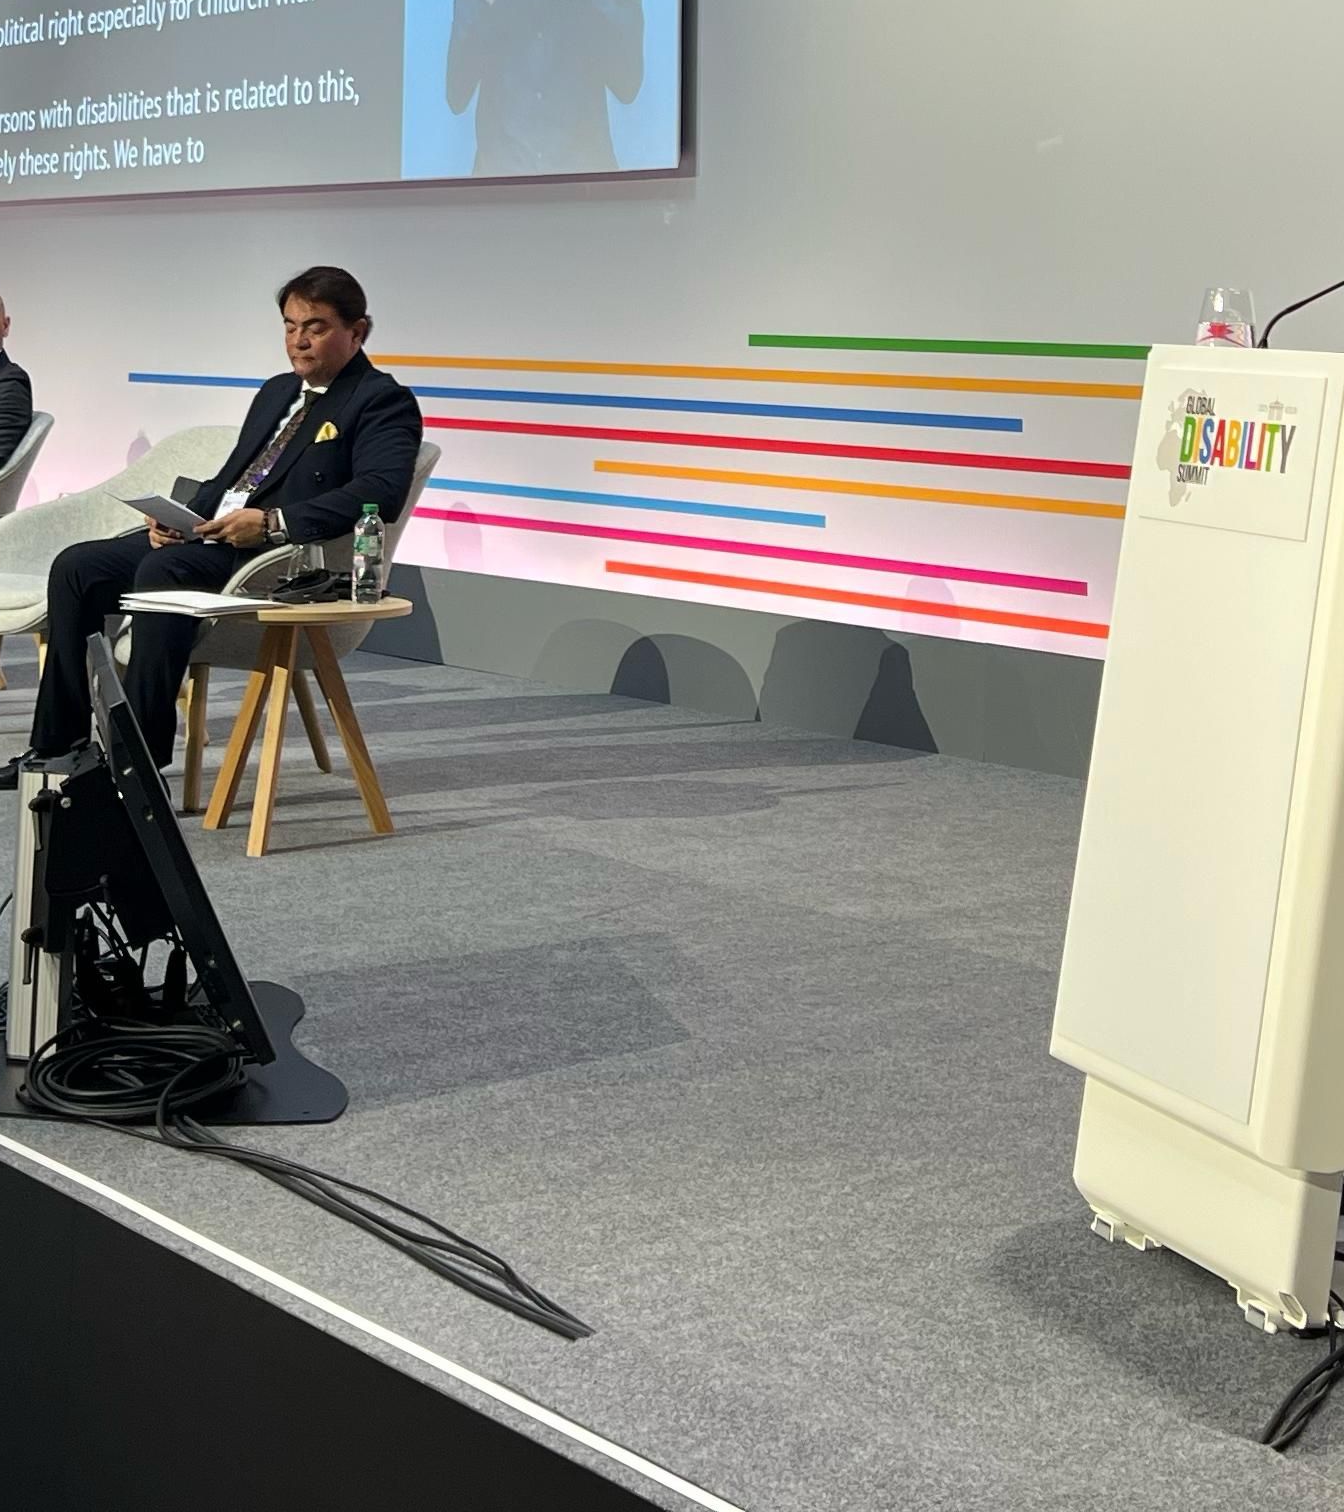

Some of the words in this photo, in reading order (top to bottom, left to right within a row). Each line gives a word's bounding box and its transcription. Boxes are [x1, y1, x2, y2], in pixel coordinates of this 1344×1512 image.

[48, 9, 84, 45] right
[39, 99, 72, 129] with
[76, 90, 162, 126] disabilities
[166, 86, 201, 117] that
[206, 82, 220, 113] is
[225, 74, 288, 112] related
[294, 76, 313, 105] to
[318, 68, 360, 106] this,
[19, 147, 59, 176] these
[63, 141, 110, 180] rights.
[113, 138, 138, 169] We
[143, 136, 182, 167] have
[187, 136, 205, 164] to
[1186, 396, 1216, 416] GLOBAL
[1179, 416, 1296, 474] DISABILITY
[1176, 463, 1210, 485] SUMMIT
